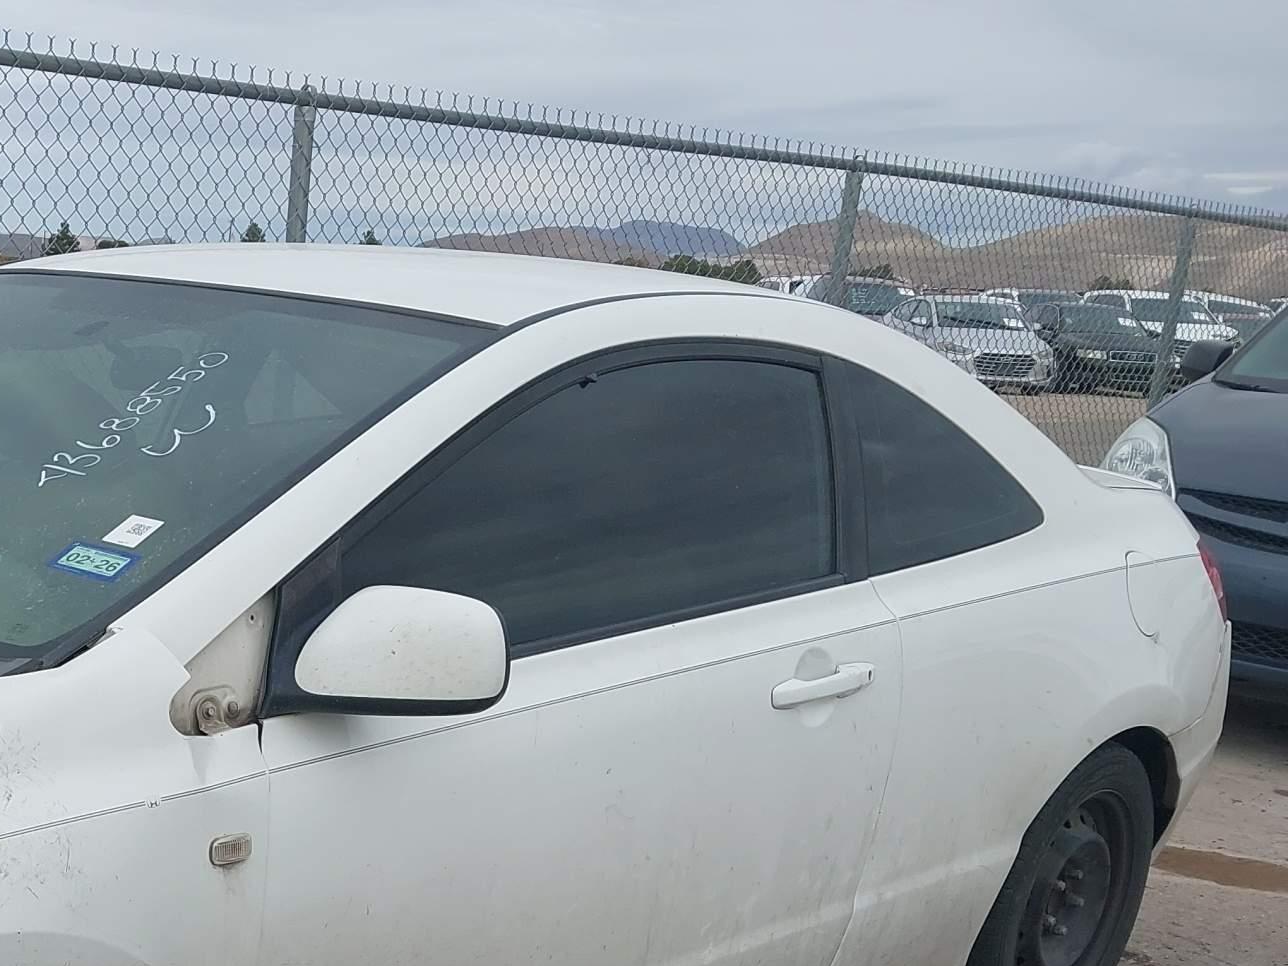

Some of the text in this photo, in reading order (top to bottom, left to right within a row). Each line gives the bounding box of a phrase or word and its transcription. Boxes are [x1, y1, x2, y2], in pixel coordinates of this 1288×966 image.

[37, 351, 229, 488] 43688550
[65, 552, 121, 573] 02 26
